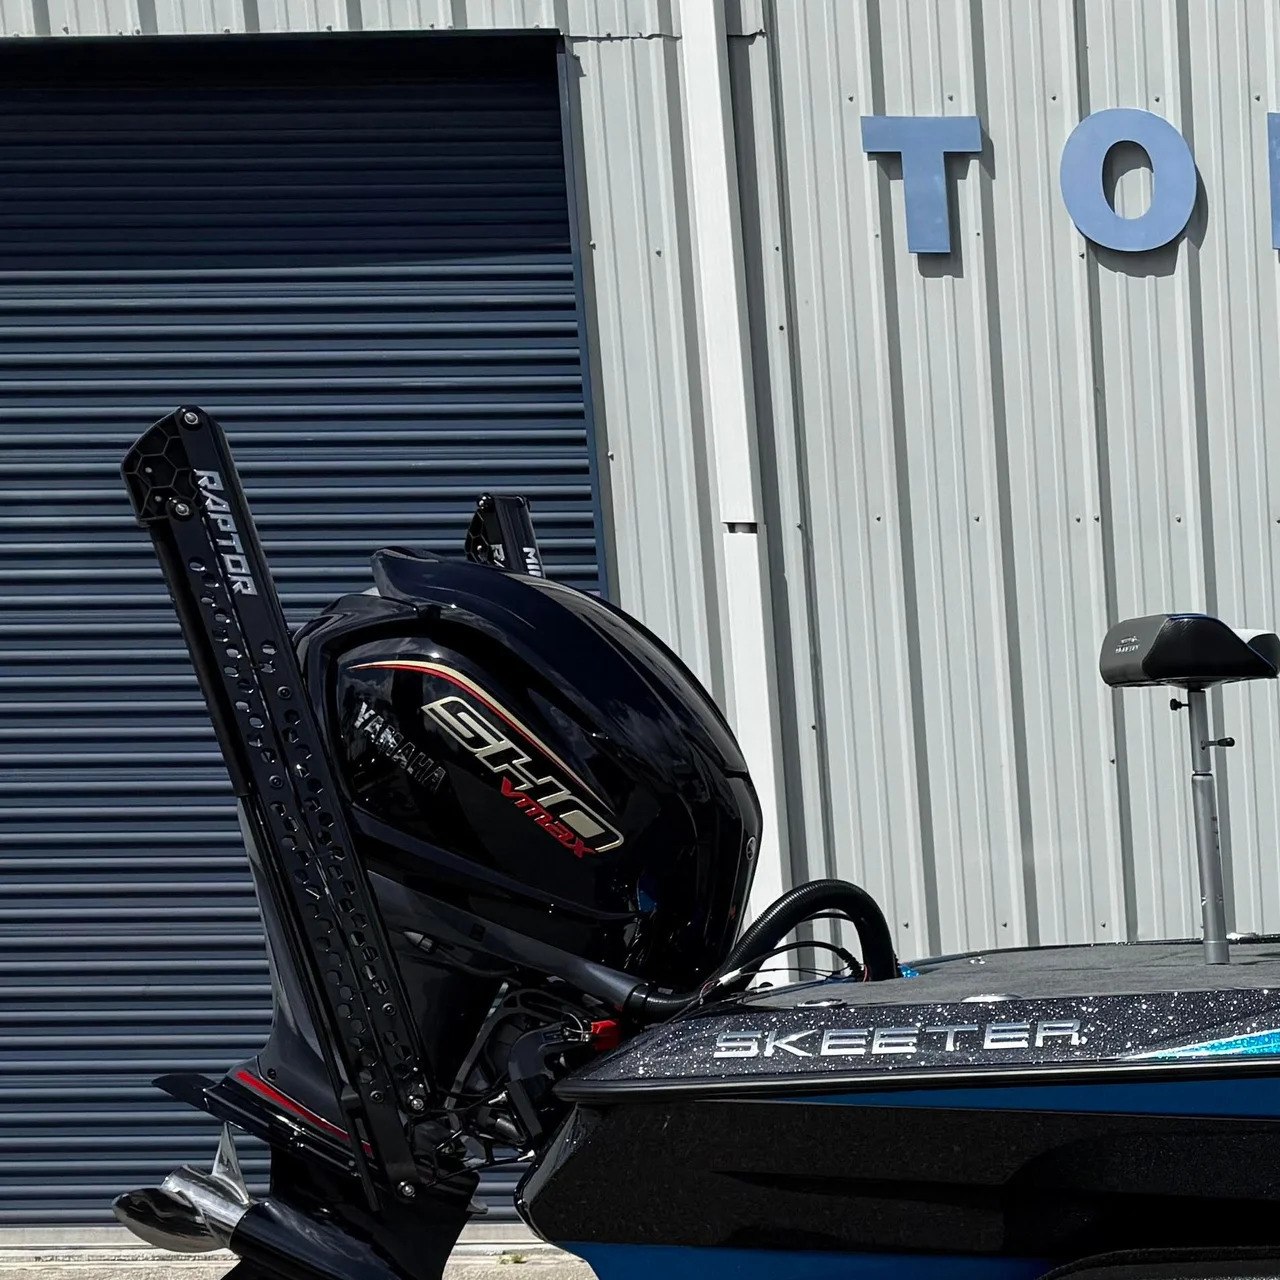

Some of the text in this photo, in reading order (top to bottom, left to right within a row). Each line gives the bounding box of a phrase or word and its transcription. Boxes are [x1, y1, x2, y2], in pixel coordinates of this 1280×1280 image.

[193, 469, 258, 596] RAPTOR
[354, 701, 447, 795] YAMAHA
[420, 696, 625, 853] SHO
[713, 1019, 1084, 1059] SKEETER
